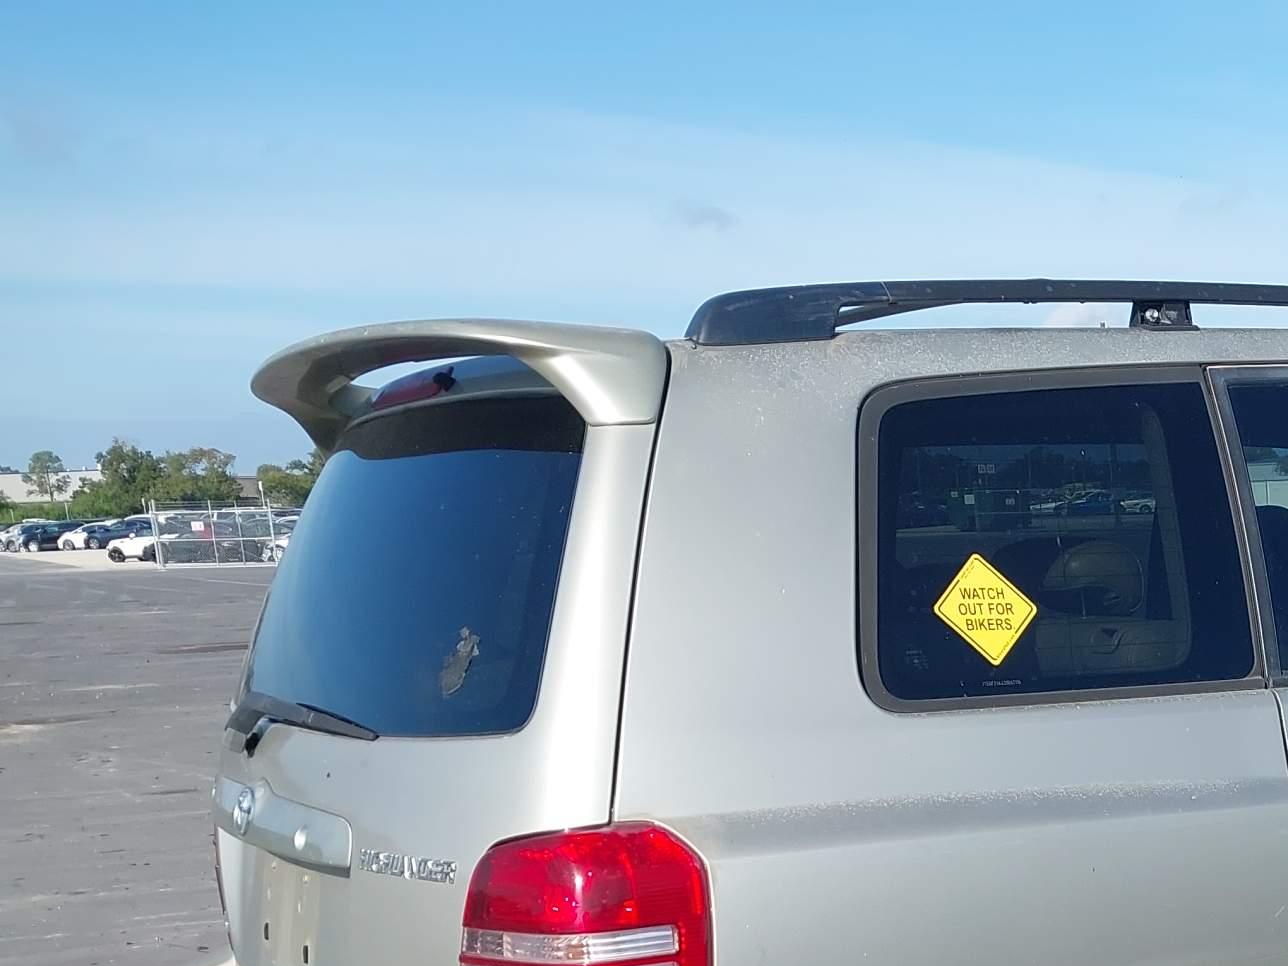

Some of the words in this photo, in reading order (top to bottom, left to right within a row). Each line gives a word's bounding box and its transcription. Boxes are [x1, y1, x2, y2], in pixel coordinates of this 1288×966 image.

[959, 587, 1005, 600] WATCH
[958, 603, 984, 615] OUT
[988, 603, 1014, 615] FOR
[965, 619, 1013, 631] BIKERS
